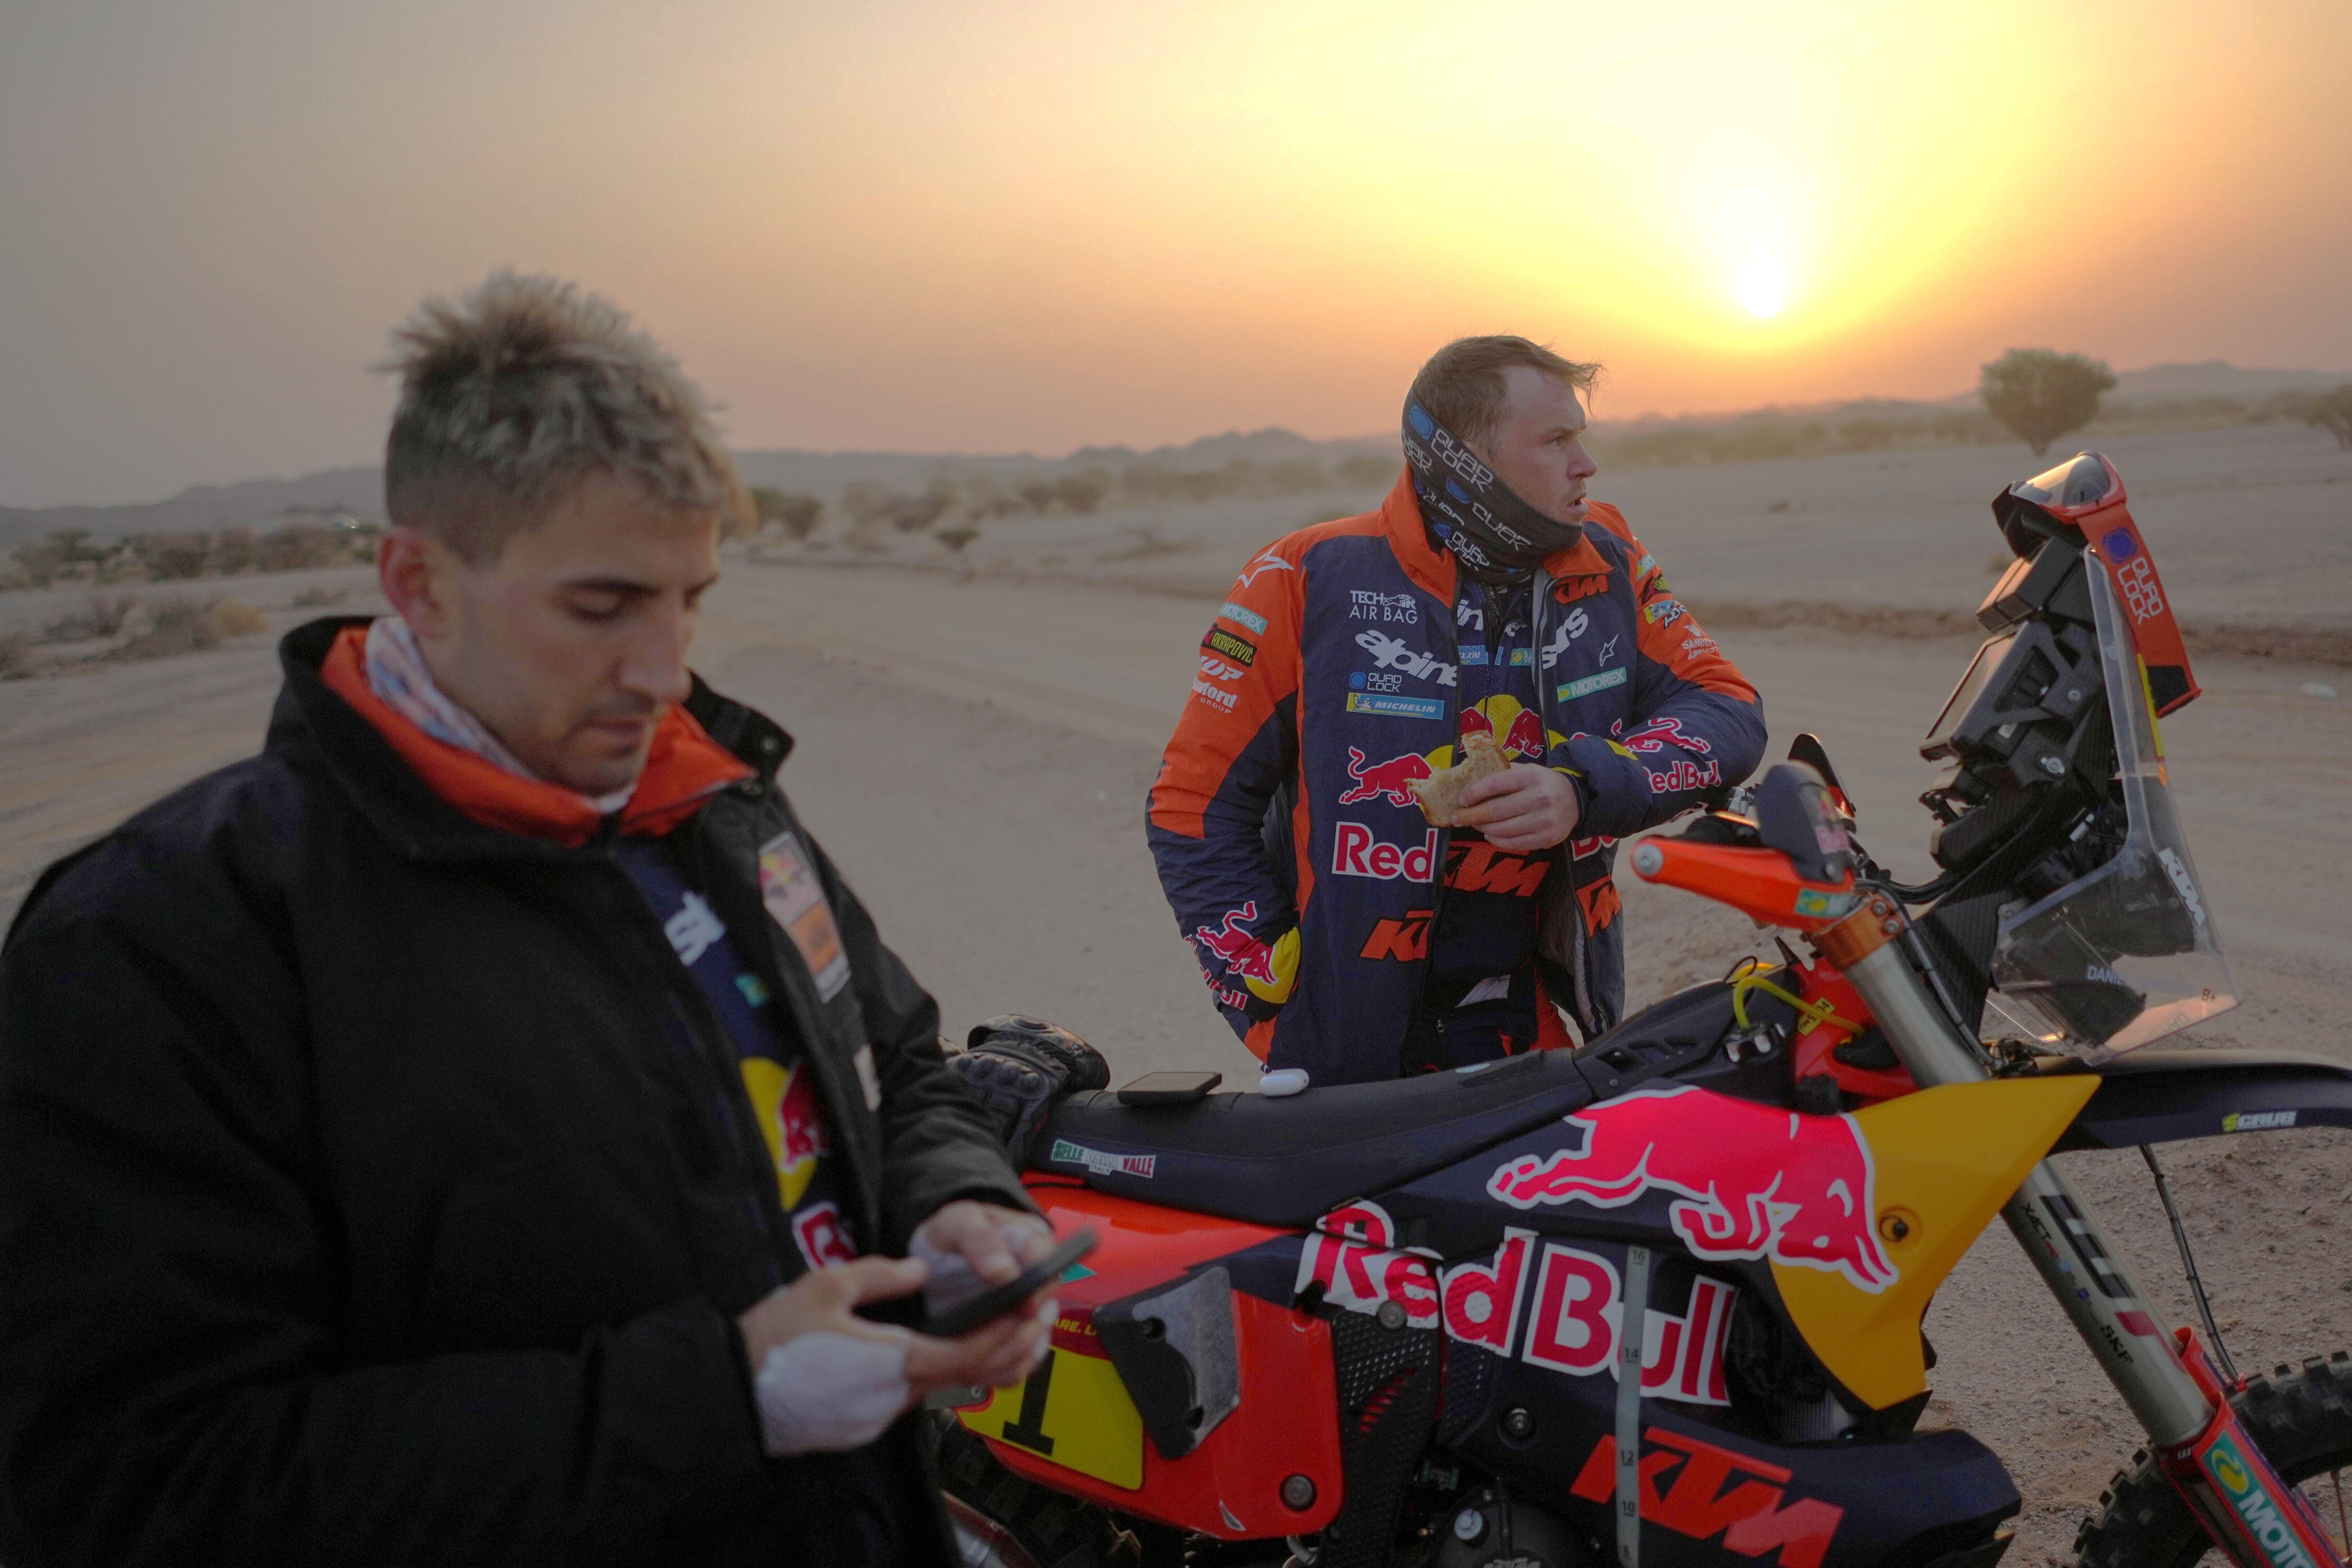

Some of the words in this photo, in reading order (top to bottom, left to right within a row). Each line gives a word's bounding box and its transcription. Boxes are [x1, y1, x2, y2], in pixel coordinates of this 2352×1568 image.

[1403, 429, 1433, 467] UAD
[1435, 428, 1494, 484] QUAD
[1431, 437, 1485, 493] LOCK
[2117, 564, 2151, 626] LOCK
[2131, 557, 2164, 616] QUAD
[1221, 604, 1264, 632] MOTOREX
[1348, 604, 1377, 620] AIR
[1383, 606, 1417, 624] BAG
[1367, 682, 1400, 693] LOCK
[1368, 672, 1402, 684] QUAD
[1570, 671, 1624, 697] MOTOREX
[1200, 697, 1231, 714] GROUP
[1375, 701, 1436, 713] MICHELIN
[1331, 821, 1439, 883] Red
[1122, 1157, 1154, 1176] VALLE
[1294, 1200, 1539, 1359] Red
[1521, 1242, 1740, 1408] Bull
[1570, 1426, 1844, 1568] KTM
